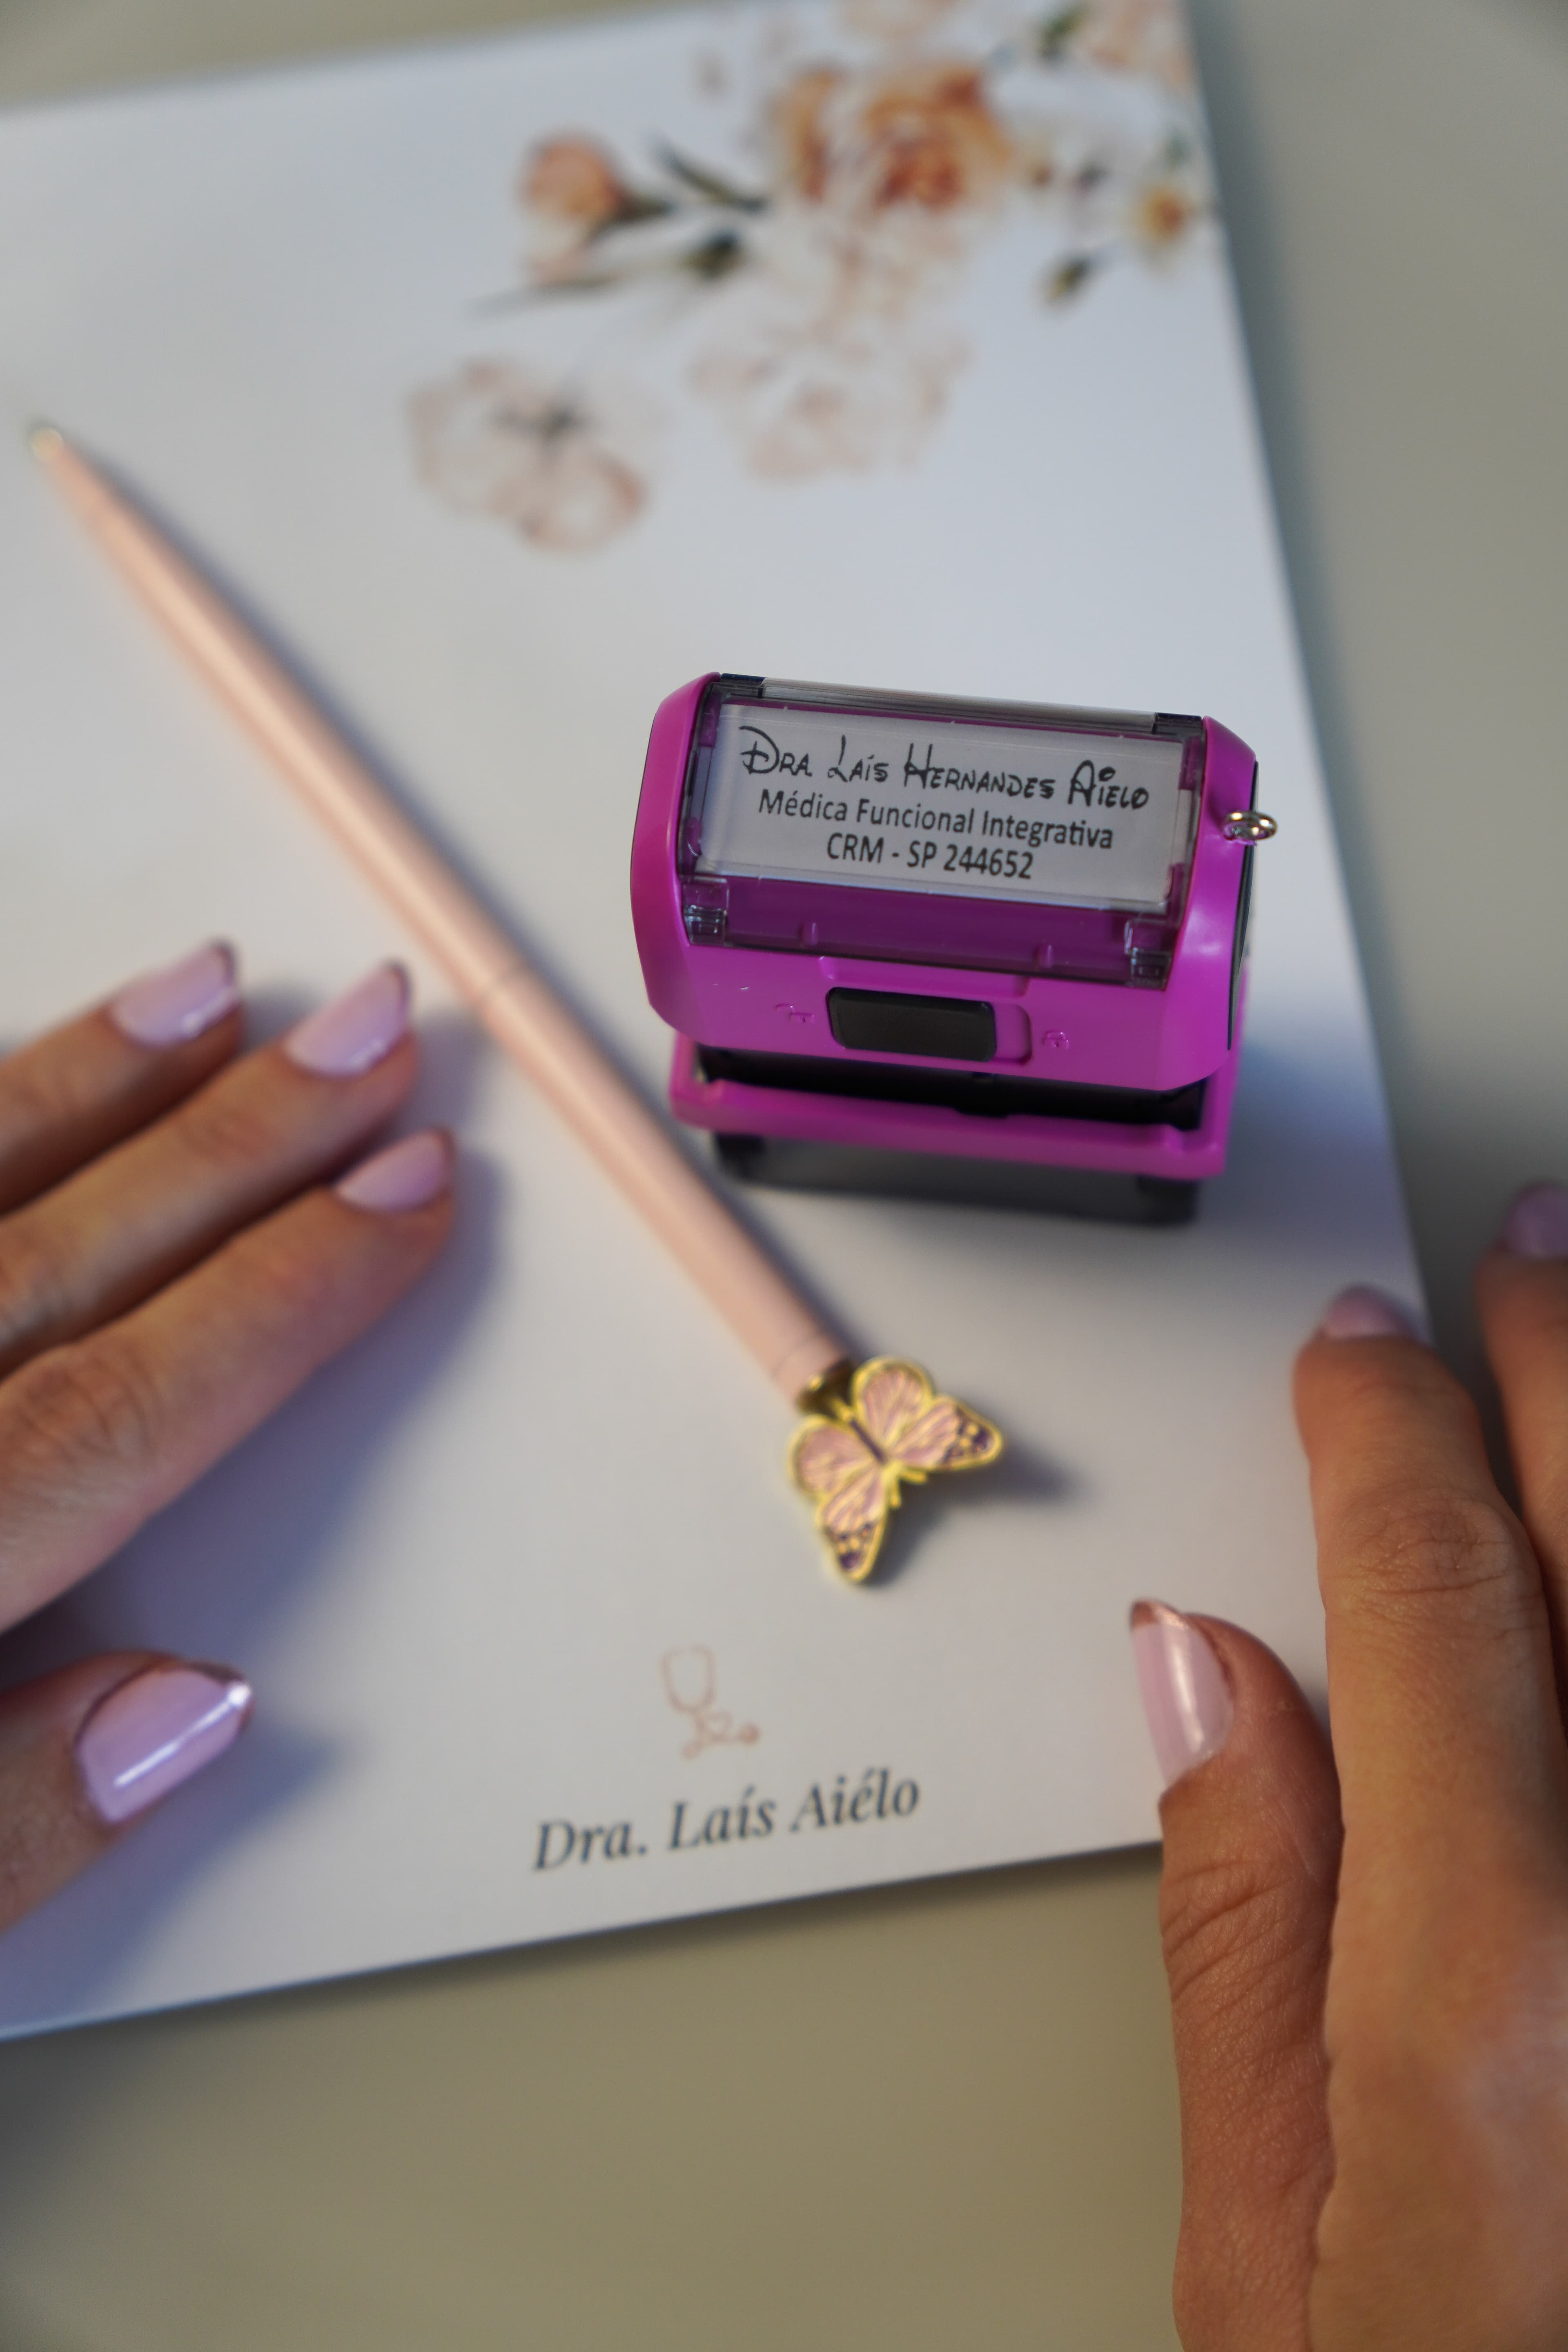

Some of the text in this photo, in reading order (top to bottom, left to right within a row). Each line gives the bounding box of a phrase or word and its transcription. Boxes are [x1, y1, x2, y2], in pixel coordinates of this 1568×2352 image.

[758, 788, 1113, 849] Médica Funcional Integrativa
[827, 832, 884, 864] CRM
[907, 840, 937, 868] SP
[943, 844, 1033, 879] 244652
[533, 1767, 920, 1872] Dra. Laís Aiélo
